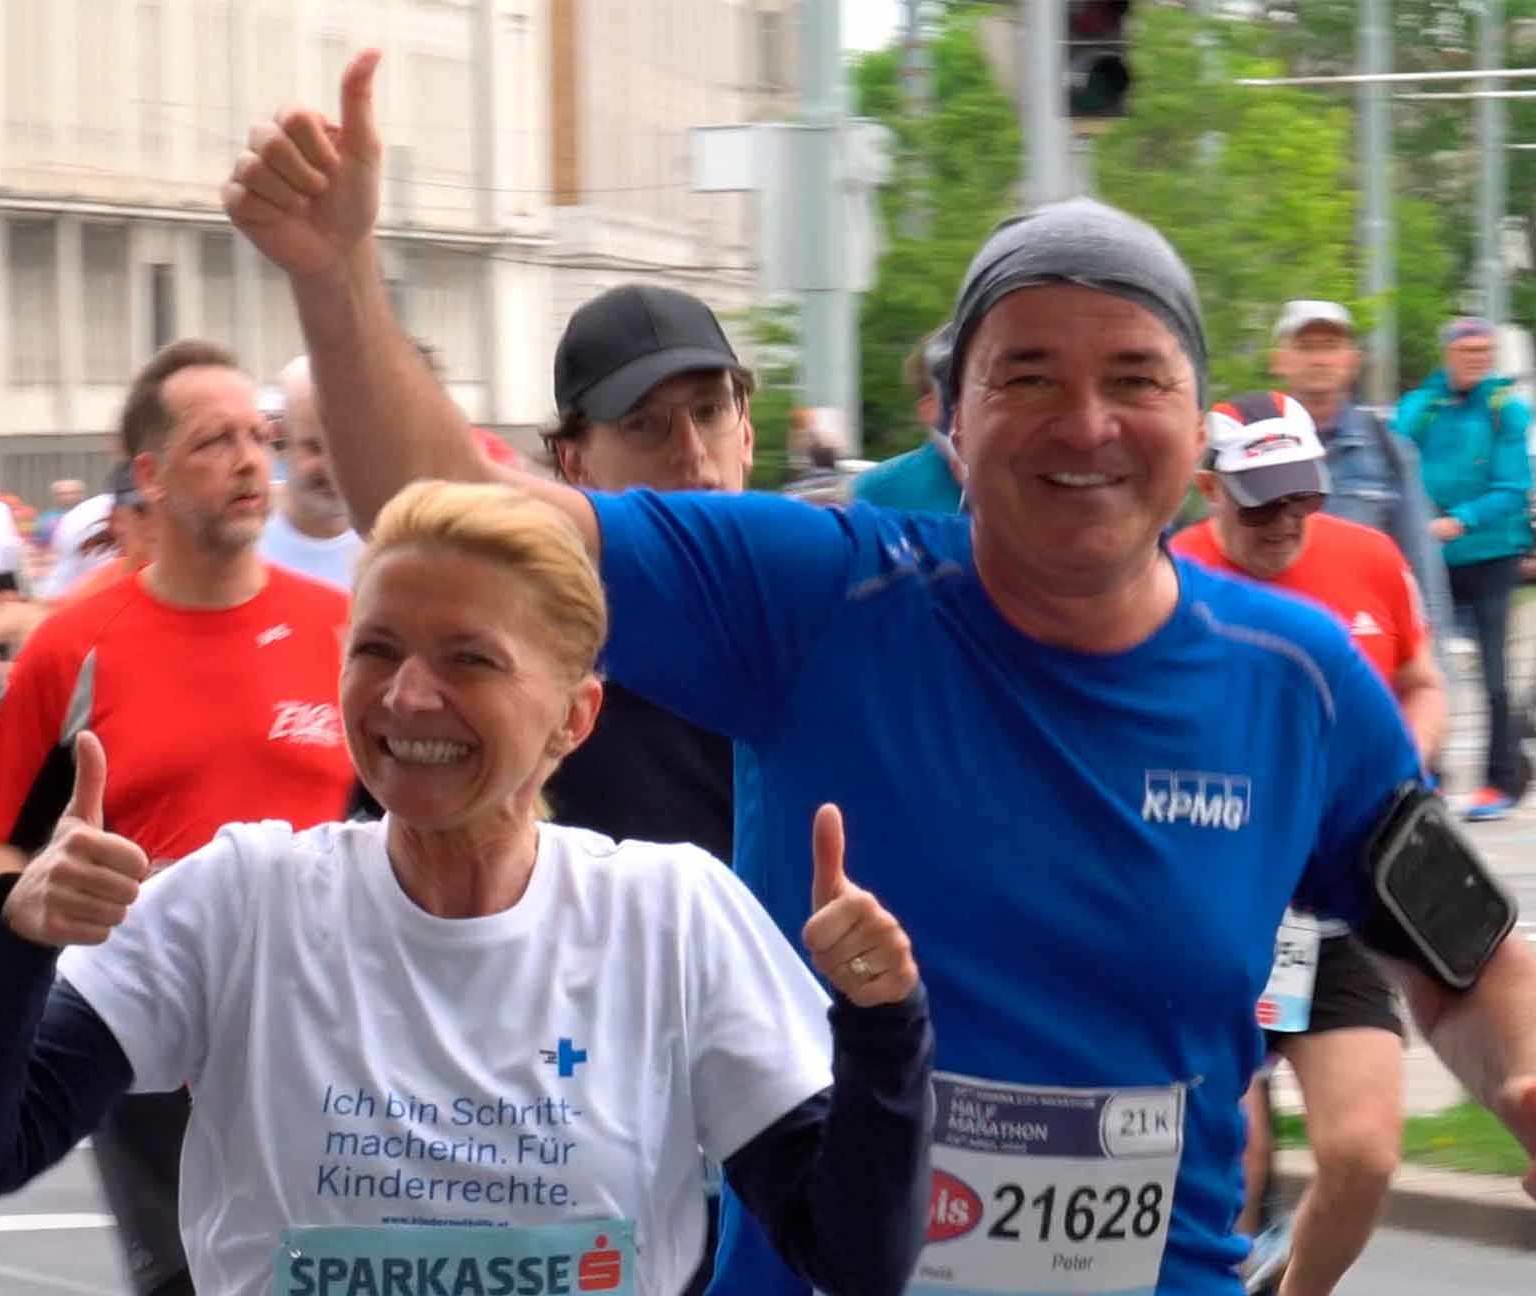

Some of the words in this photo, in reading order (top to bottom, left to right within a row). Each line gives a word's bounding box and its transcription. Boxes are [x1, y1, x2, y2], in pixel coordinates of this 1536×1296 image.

[1142, 788, 1244, 832] KPMG
[322, 1085, 375, 1119] Ich
[385, 1091, 438, 1125] bin
[450, 1096, 583, 1127] Schritt-
[325, 1126, 508, 1165] macherin.
[518, 1133, 577, 1166] Für
[947, 1114, 1049, 1142] MARATHON
[316, 1165, 579, 1208] Kinderrechte.
[987, 1181, 1164, 1242] 21628
